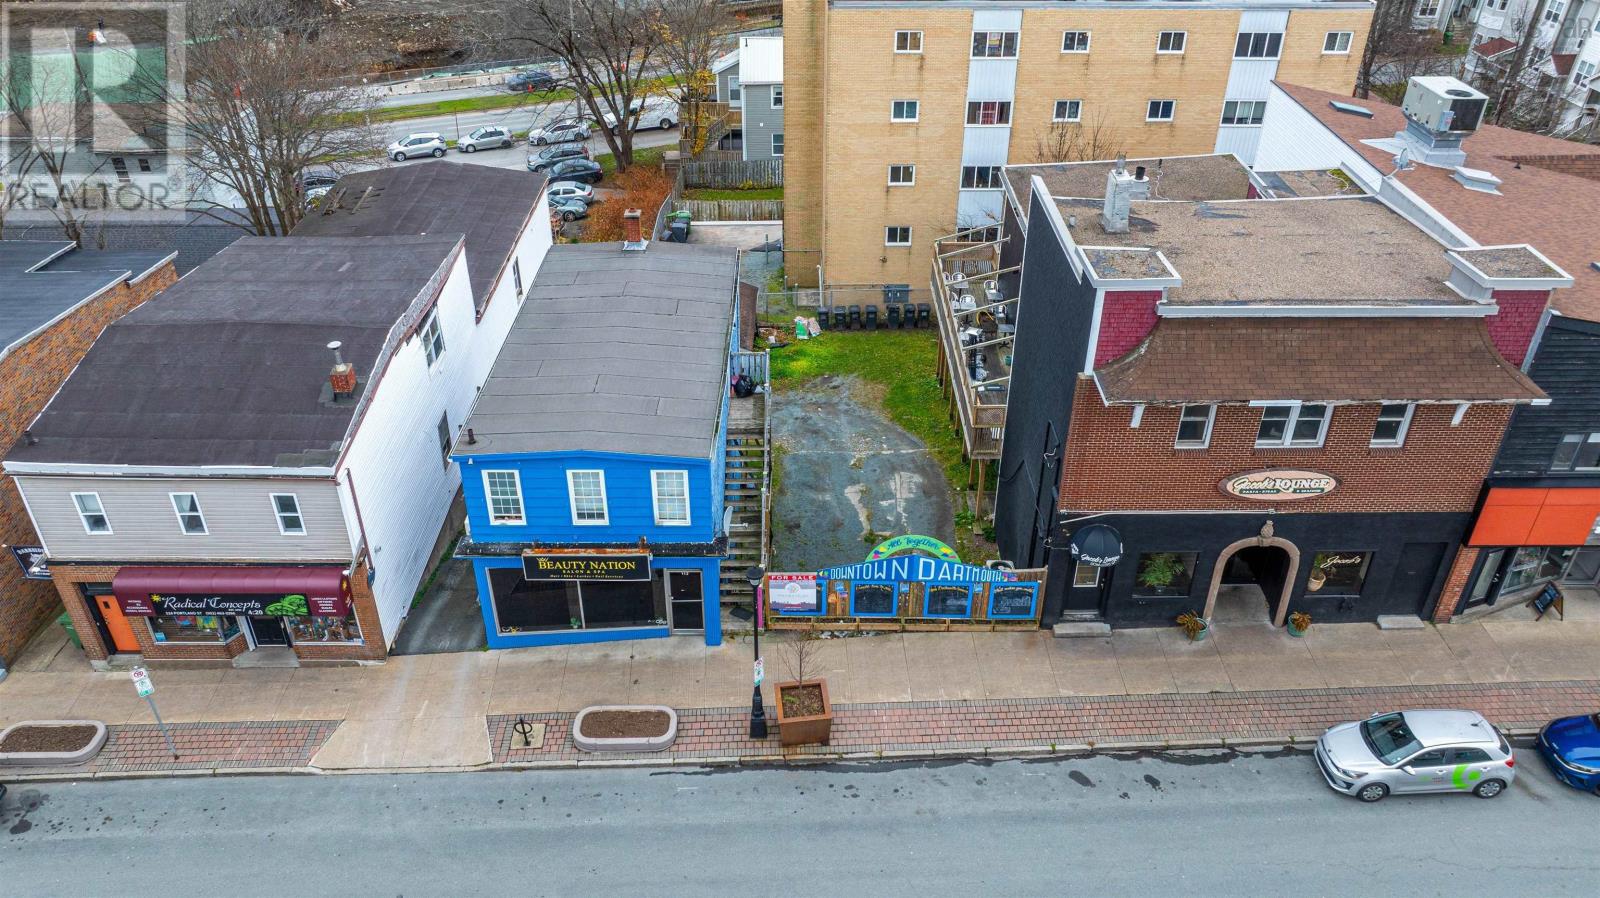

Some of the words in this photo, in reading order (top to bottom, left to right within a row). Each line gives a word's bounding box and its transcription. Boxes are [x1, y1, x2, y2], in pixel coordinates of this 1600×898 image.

[1274, 478, 1330, 492] LOUNGE
[539, 560, 586, 570] BEAUTY
[590, 561, 636, 570] NATION
[830, 557, 909, 580] DOWNTOWN
[918, 558, 1001, 582] DARTMOUTH
[161, 596, 206, 611] Radical
[207, 597, 261, 612] Concepts
